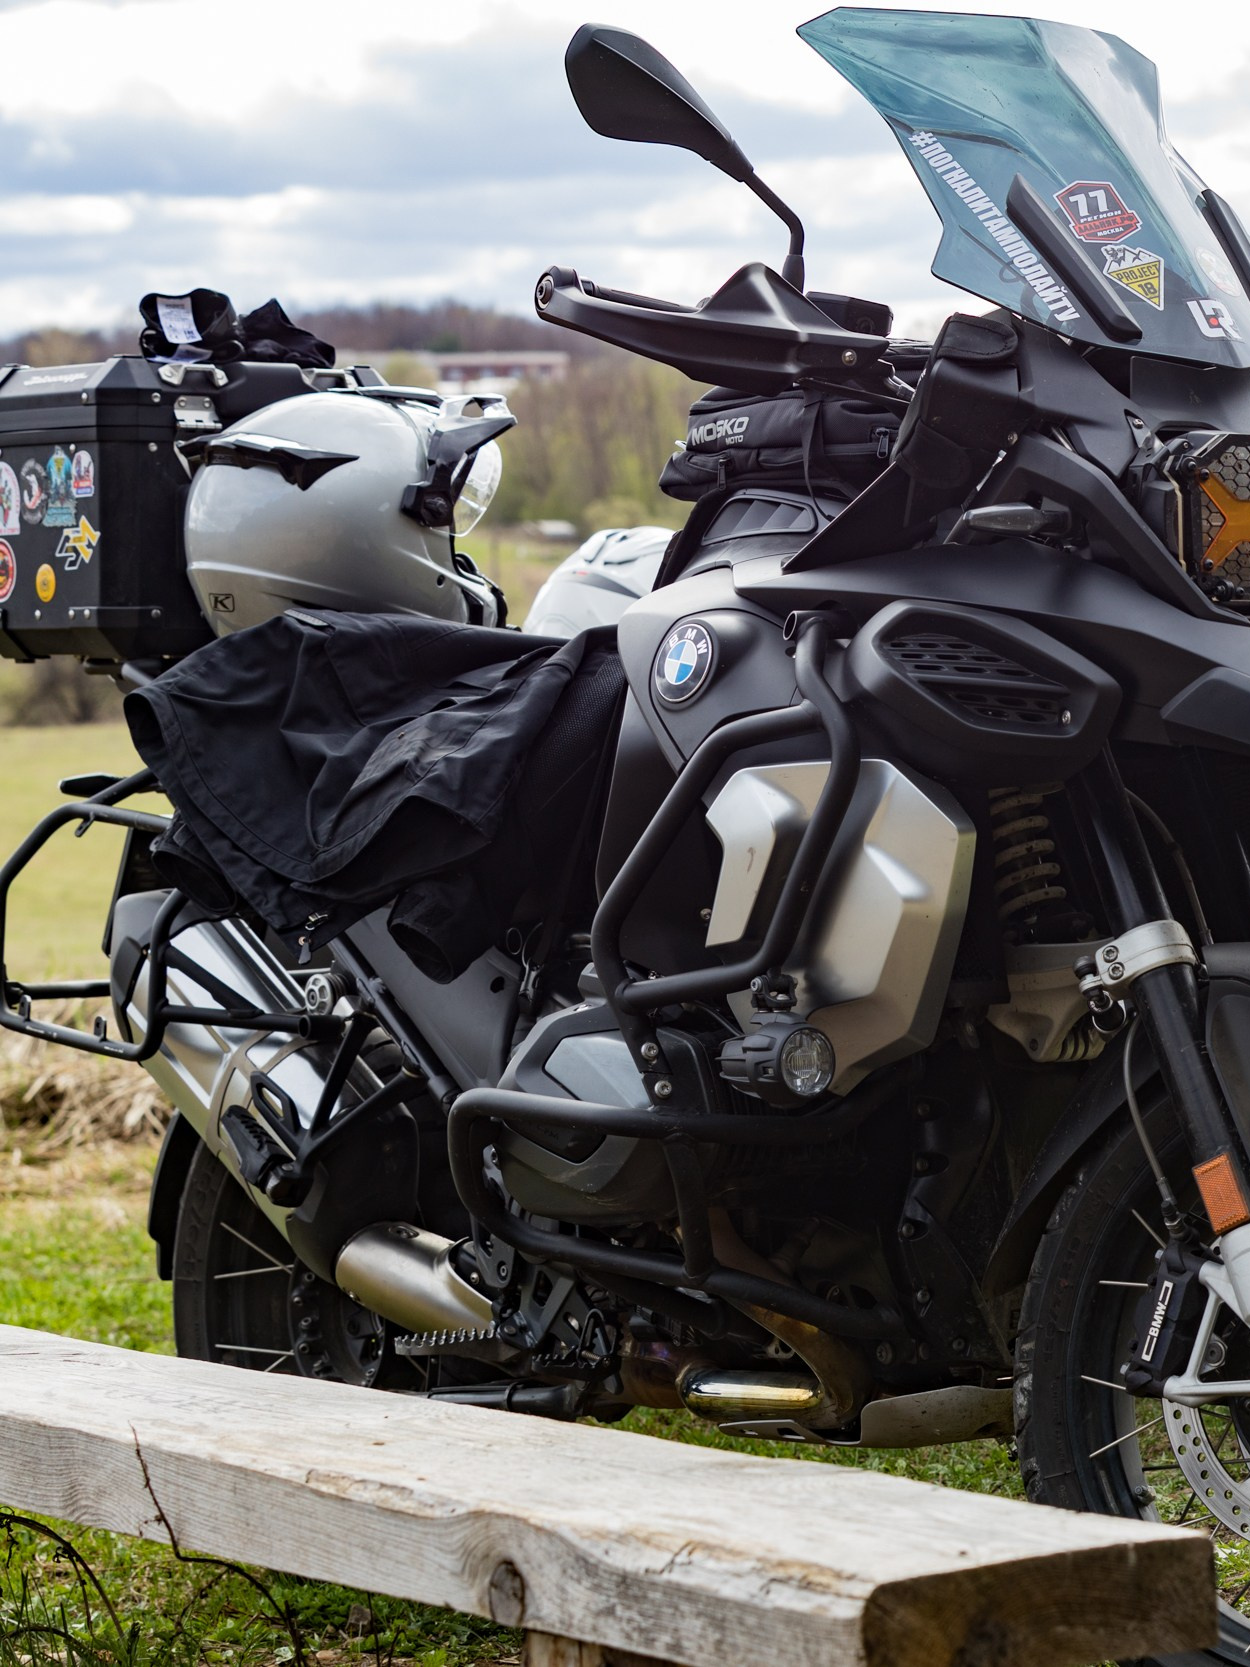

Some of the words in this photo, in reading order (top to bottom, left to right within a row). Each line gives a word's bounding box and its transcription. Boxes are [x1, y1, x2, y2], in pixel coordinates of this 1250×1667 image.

[1068, 189, 1110, 217] 77
[907, 130, 1081, 322] #ПОГНАЛИТАМПОЛАЙТУ
[1080, 209, 1122, 224] РЕГИОН
[1097, 226, 1124, 237] МОСКВА
[1115, 263, 1159, 282] PROJECT
[1137, 282, 1158, 297] 18
[691, 416, 750, 447] MOSKO
[725, 434, 744, 446] MOTO
[213, 596, 231, 610] K
[668, 627, 708, 655] BMW
[1148, 1301, 1167, 1338] BMW
